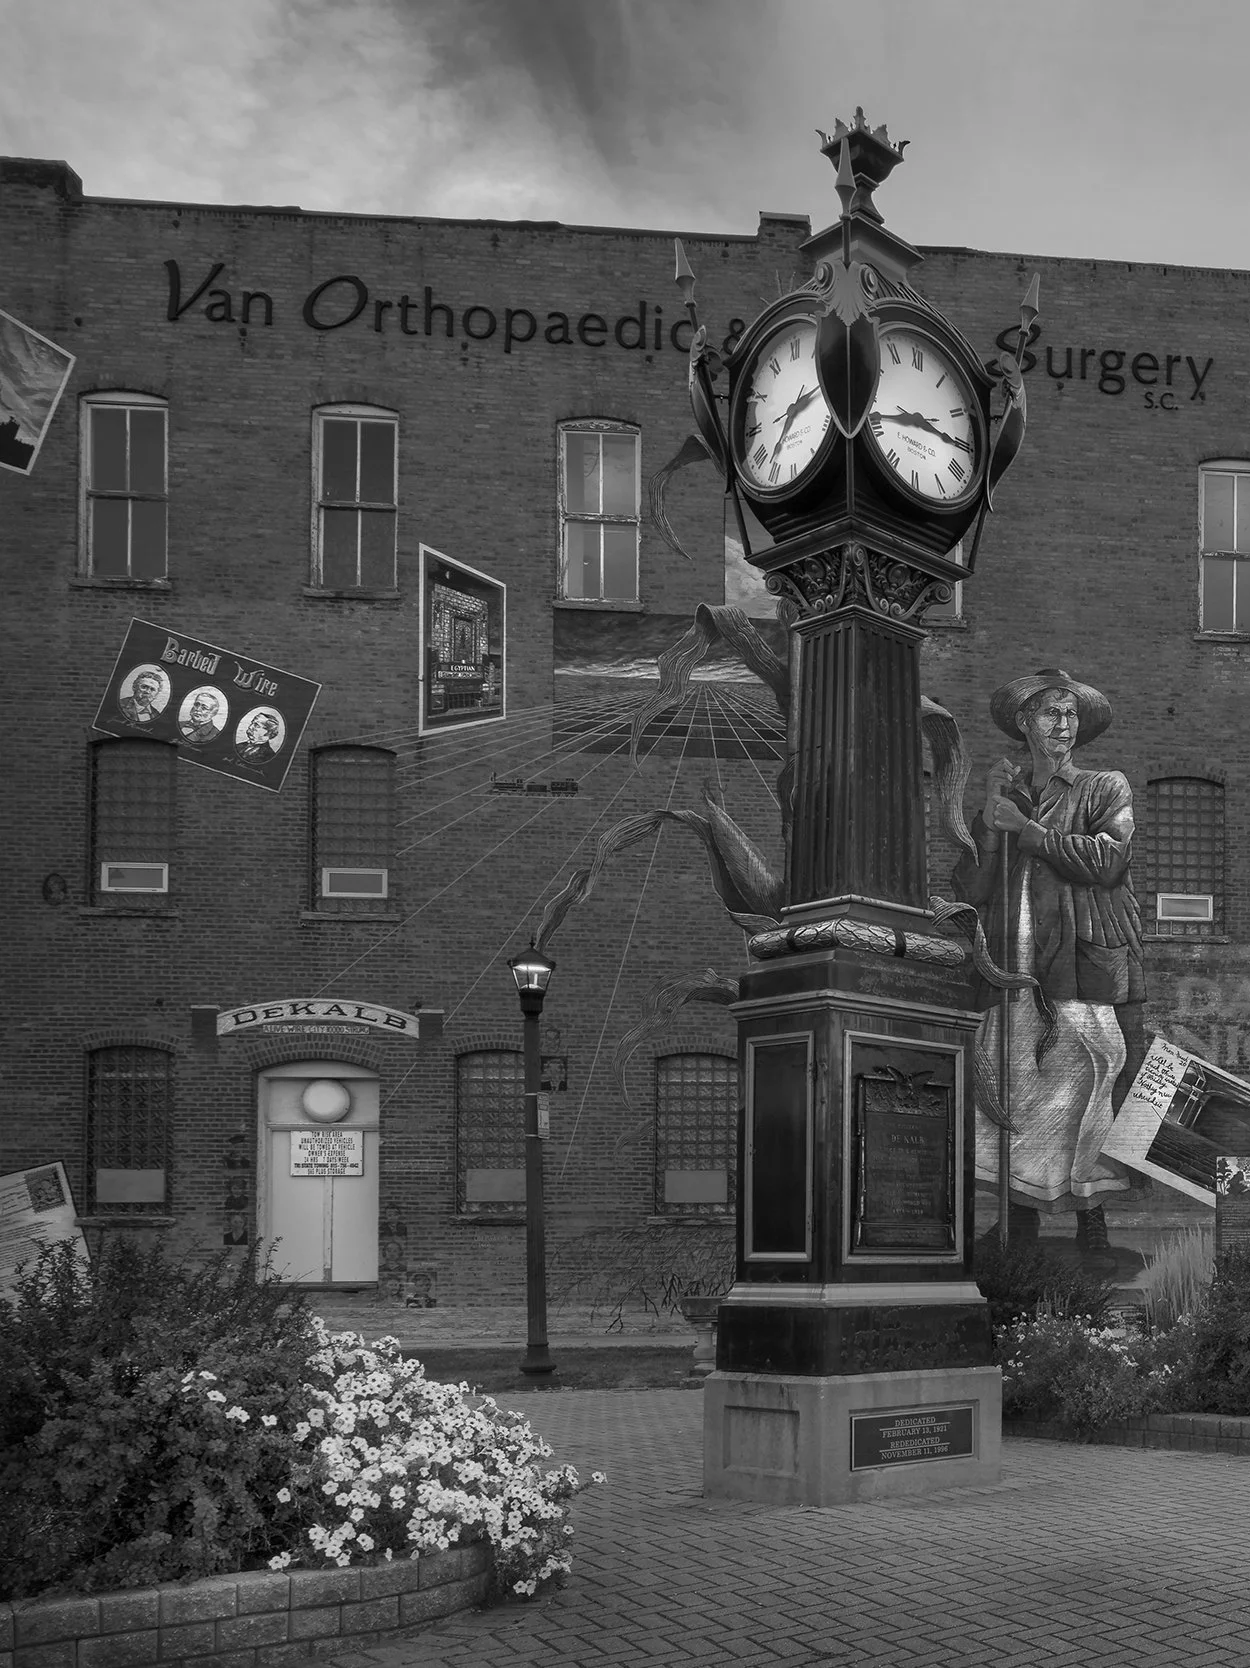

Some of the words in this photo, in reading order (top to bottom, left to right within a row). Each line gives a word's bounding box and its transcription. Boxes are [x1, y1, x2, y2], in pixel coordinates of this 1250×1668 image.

[164, 259, 273, 326] Van
[303, 275, 693, 353] Orthopaedic
[984, 323, 1213, 401] Surgery
[1144, 391, 1179, 411] S.C.
[906, 446, 927, 460] BOSTON
[232, 660, 279, 697] Wire
[895, 1416, 936, 1427] DEDICATED
[882, 1427, 921, 1439] FEBRUARY
[922, 1426, 932, 1435] 13,
[933, 1425, 947, 1434] 1921
[890, 1436, 940, 1449] REDEDICATED
[881, 1447, 922, 1460] NOVEMBER
[923, 1447, 933, 1456] 11,
